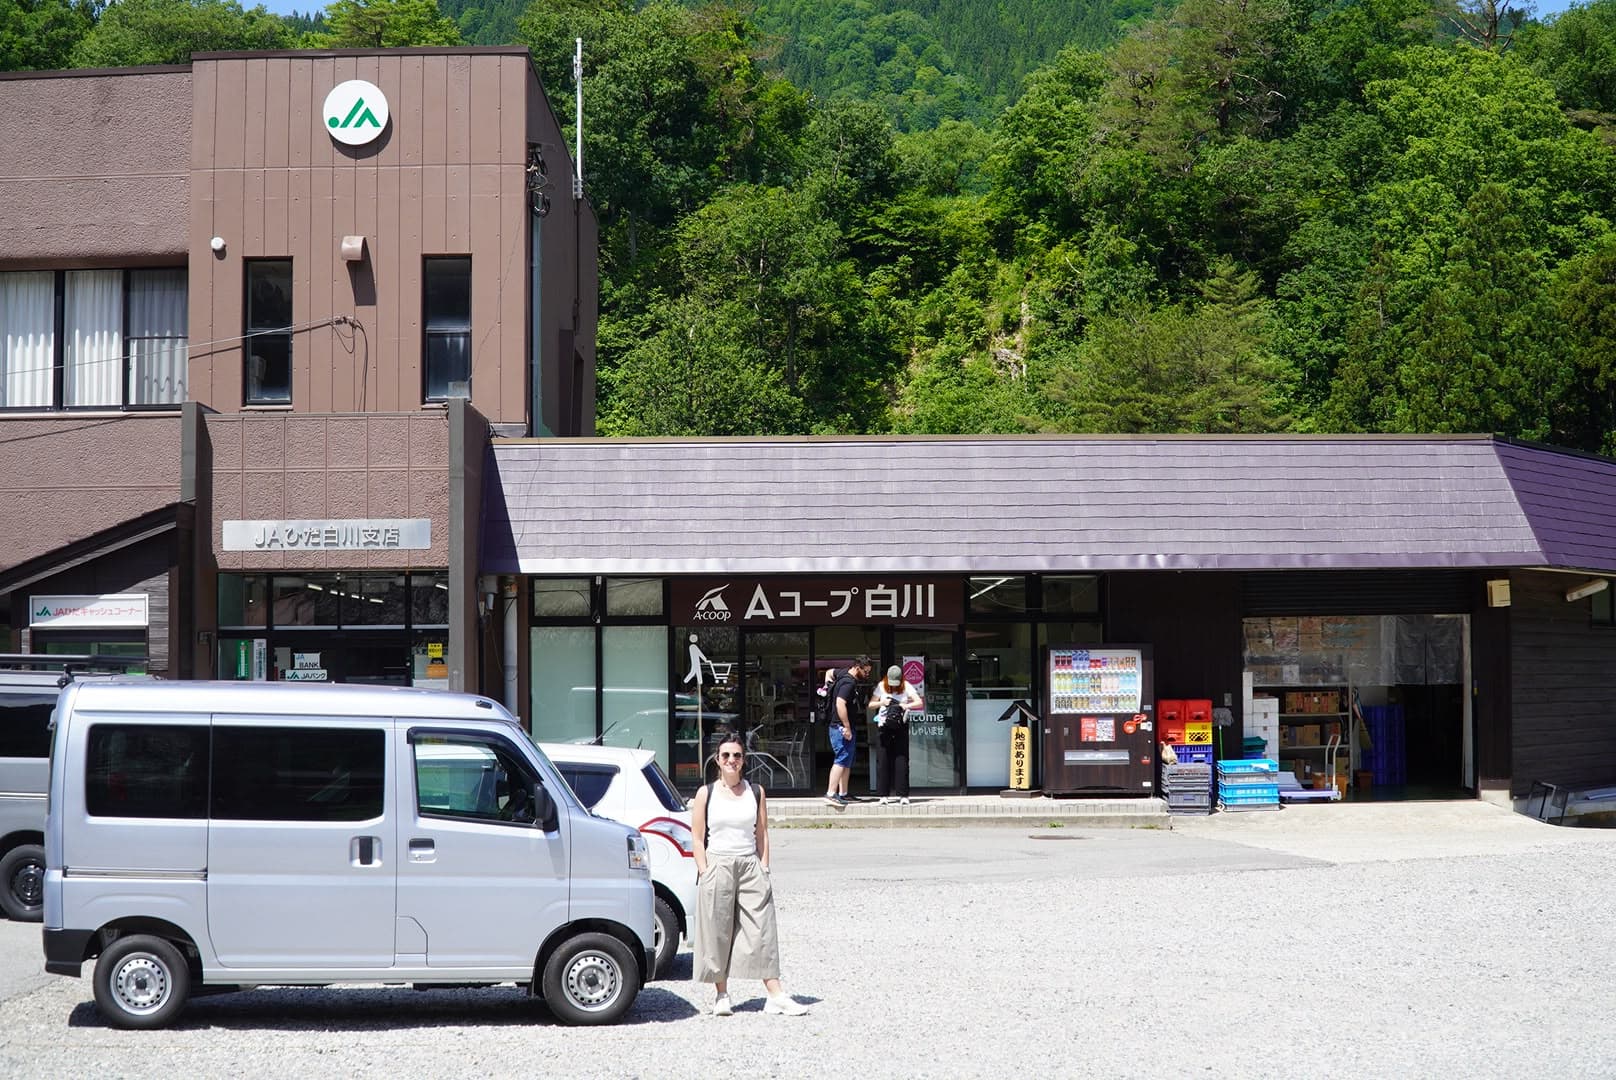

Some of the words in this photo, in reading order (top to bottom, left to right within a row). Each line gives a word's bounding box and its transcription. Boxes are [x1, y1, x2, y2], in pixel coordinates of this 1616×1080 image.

[255, 525, 401, 548] JAひだ白川支店
[743, 583, 935, 620] Aコープ白川
[53, 606, 143, 617] JAひだキャッシュコーナー
[301, 672, 326, 680] JAバンク
[909, 726, 945, 736] しゃいませ
[1014, 732, 1026, 786] 地酒あります
